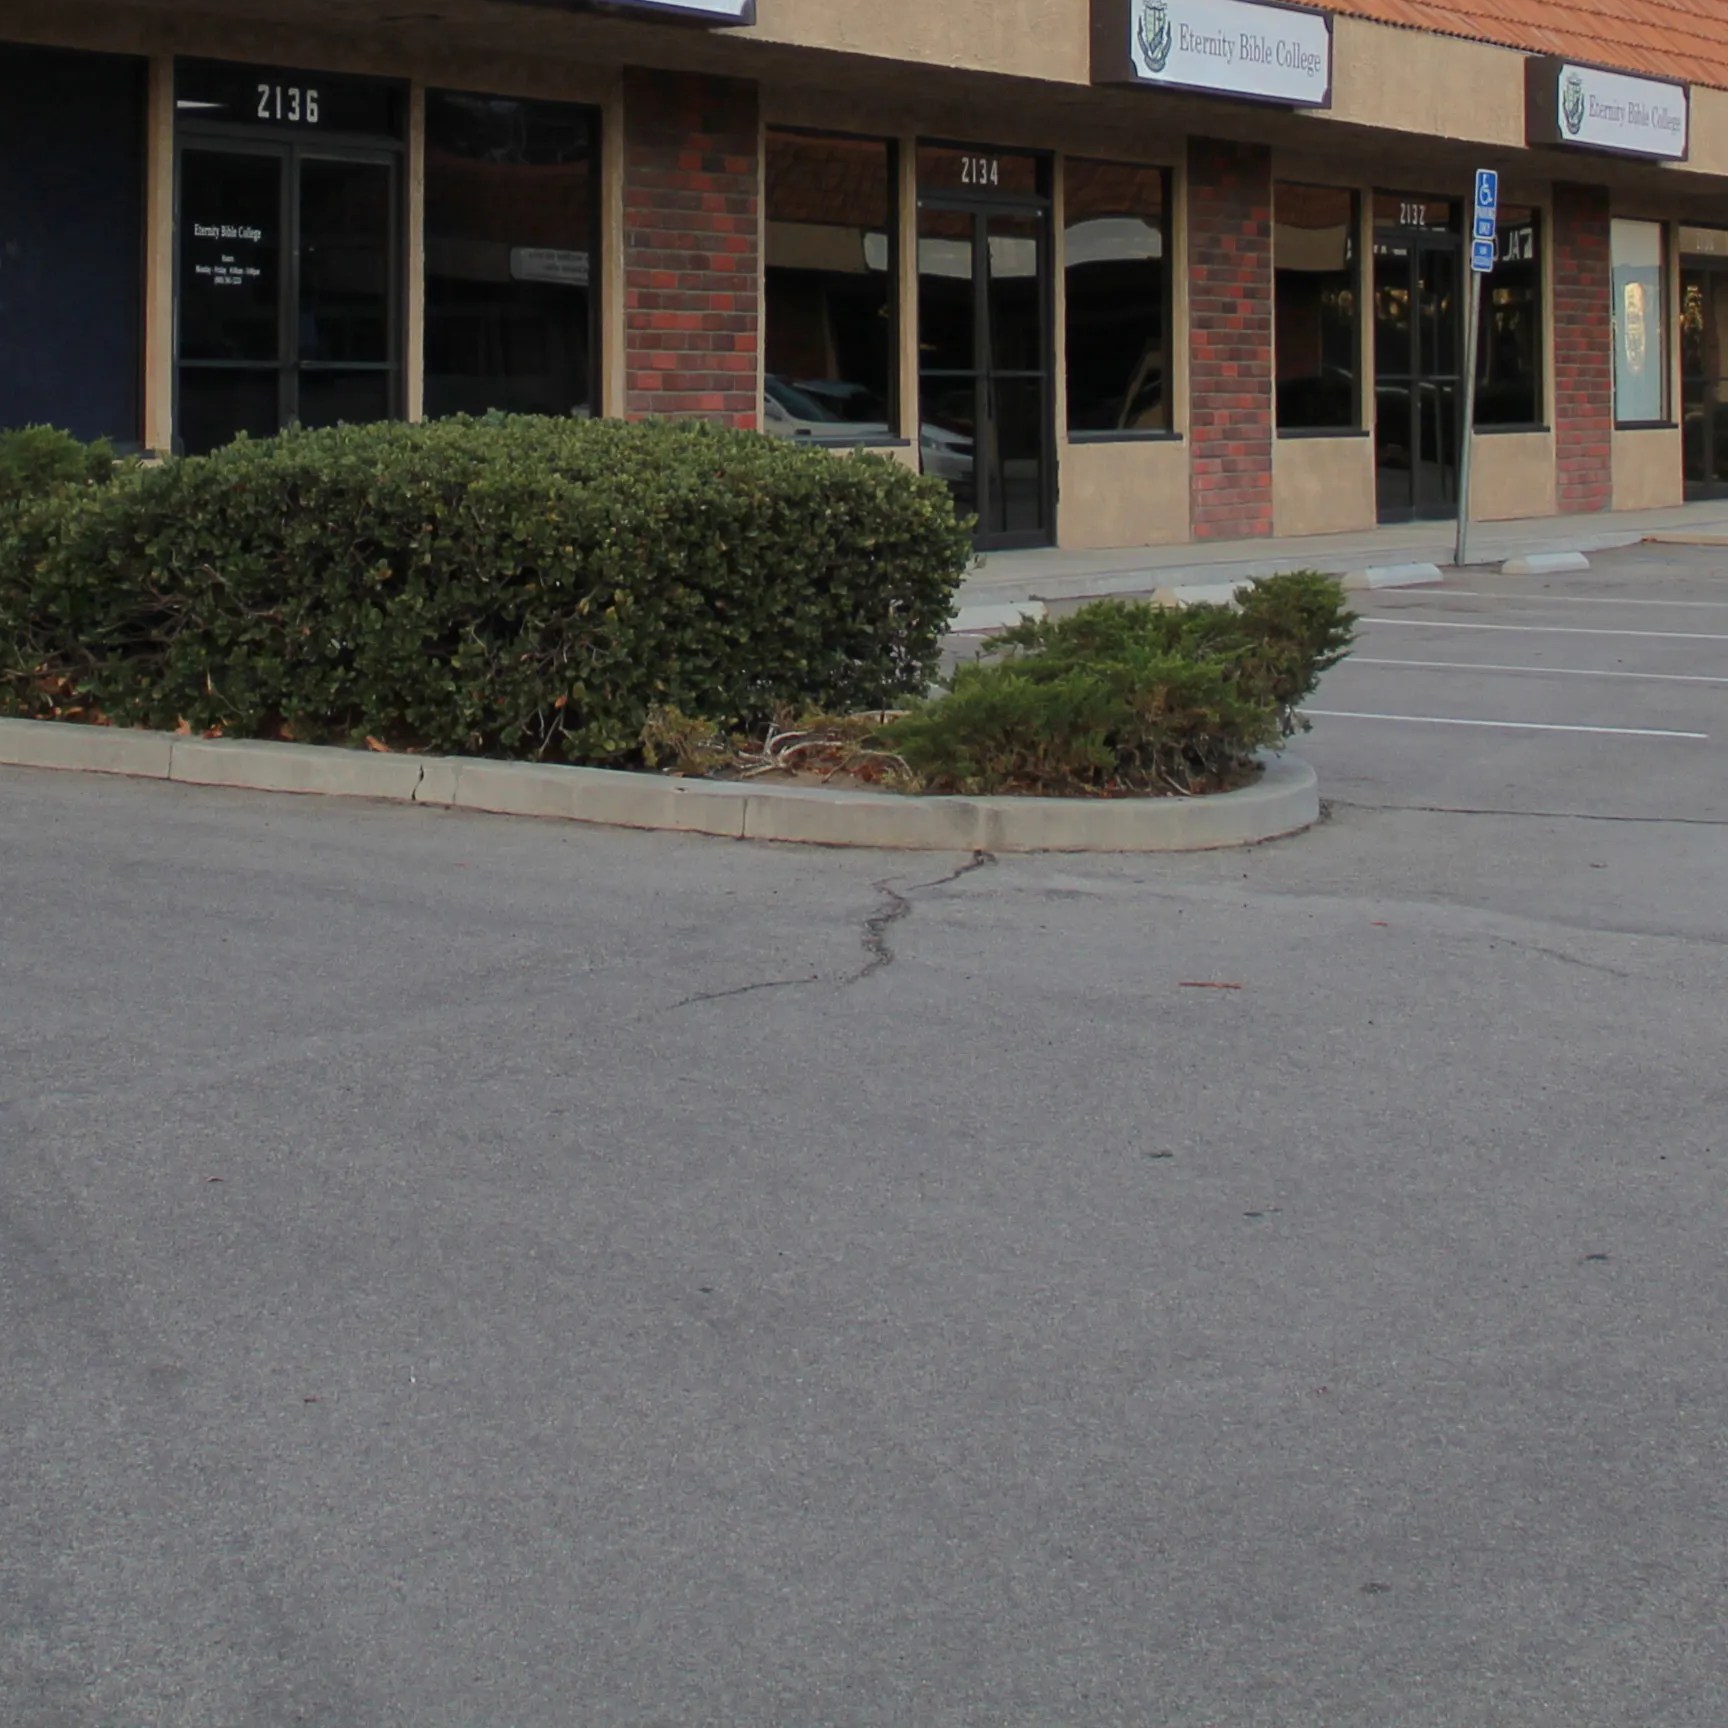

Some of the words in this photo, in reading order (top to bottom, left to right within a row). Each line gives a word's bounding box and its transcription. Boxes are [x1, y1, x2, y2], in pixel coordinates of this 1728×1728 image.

[1179, 23, 1235, 63] Eternity
[1240, 33, 1272, 64] Bible
[1276, 39, 1321, 76] College
[257, 84, 319, 123] 2136
[1589, 94, 1625, 127] Eternity
[961, 157, 999, 185] 2134
[1400, 203, 1426, 226] 2132
[194, 223, 220, 239] Eternity
